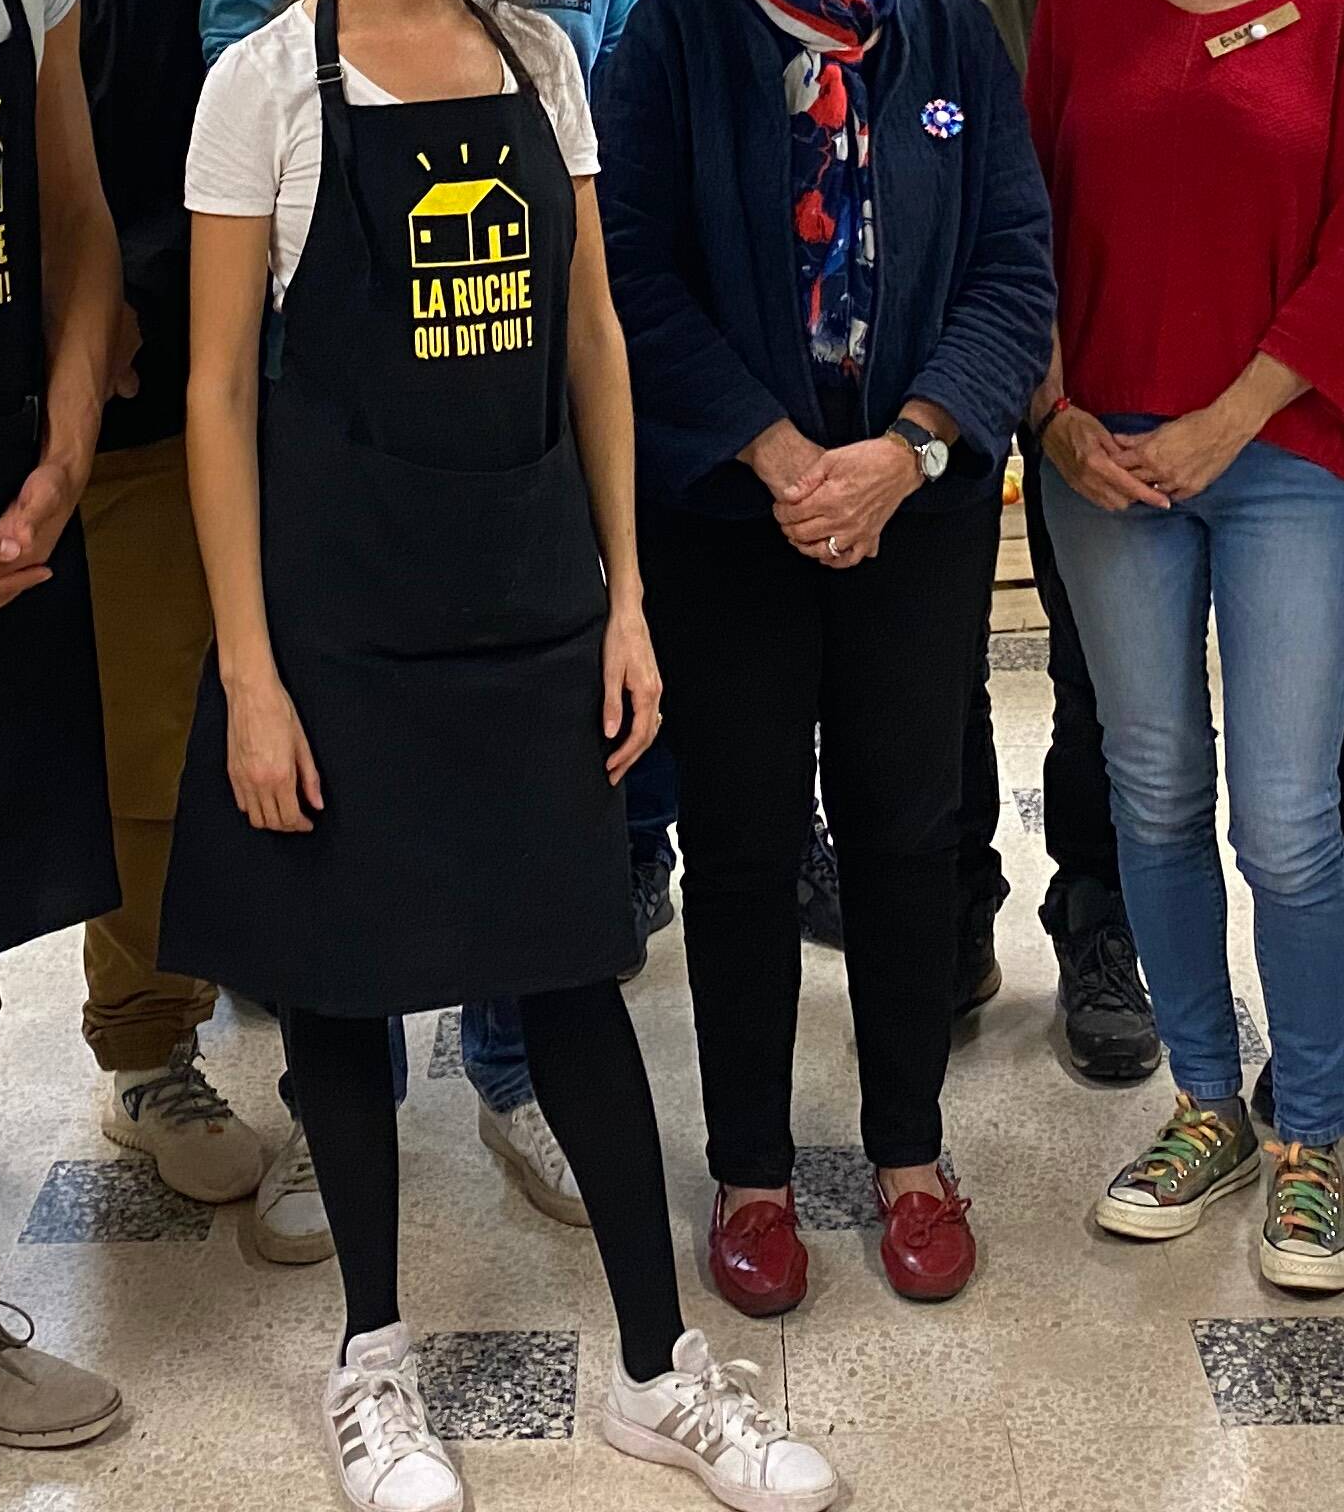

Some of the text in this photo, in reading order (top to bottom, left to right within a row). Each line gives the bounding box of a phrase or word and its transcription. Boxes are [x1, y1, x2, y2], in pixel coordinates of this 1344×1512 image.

[412, 270, 532, 319] LA RUCHE
[414, 325, 450, 359] QUI
[456, 323, 487, 356] DIT
